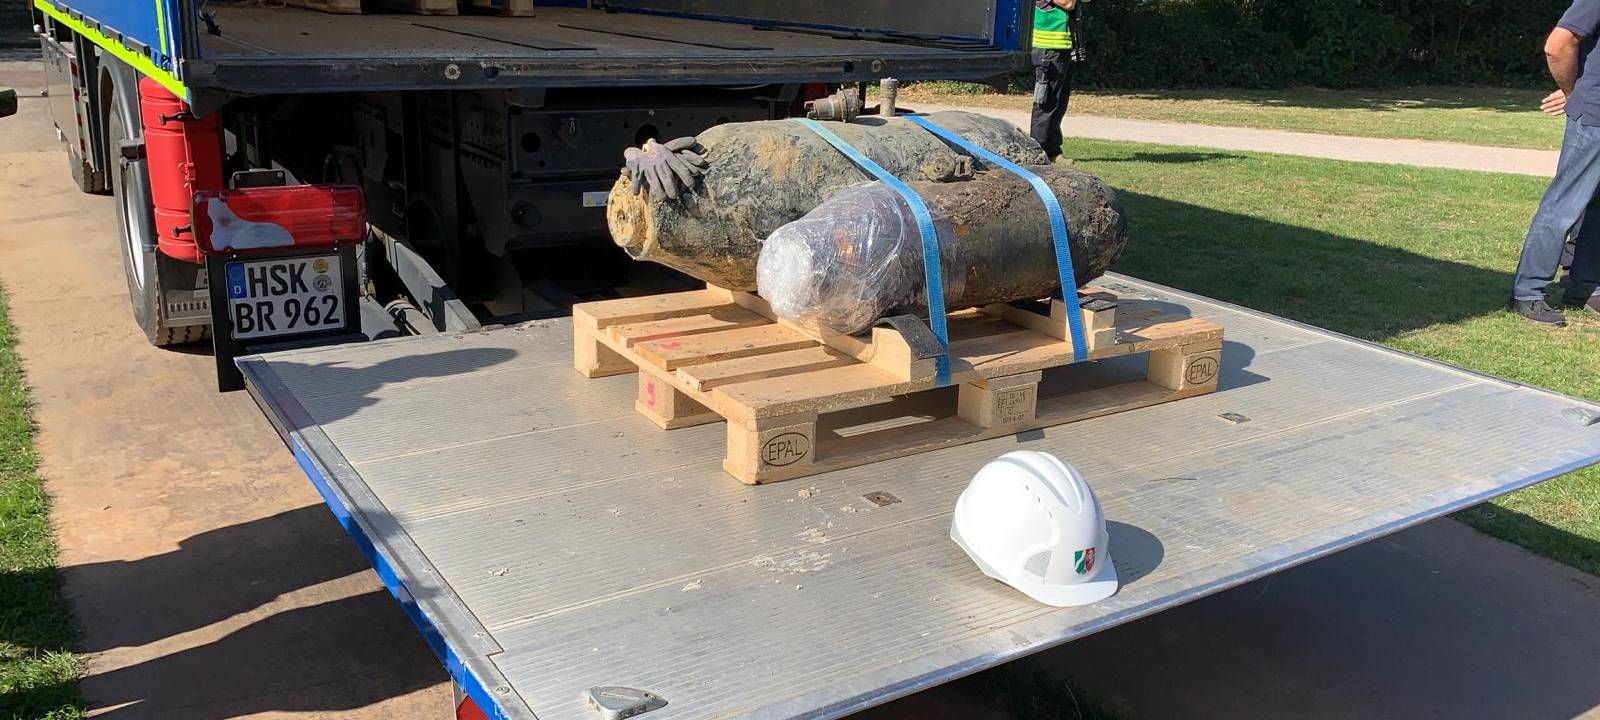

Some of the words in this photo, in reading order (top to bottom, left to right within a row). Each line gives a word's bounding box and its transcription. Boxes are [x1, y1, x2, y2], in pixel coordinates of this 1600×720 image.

[233, 284, 242, 295] D
[247, 263, 309, 298] HSK
[235, 301, 277, 334] BR
[283, 294, 340, 330] 962
[1190, 361, 1213, 381] EPAL
[769, 439, 803, 462] EPAL
